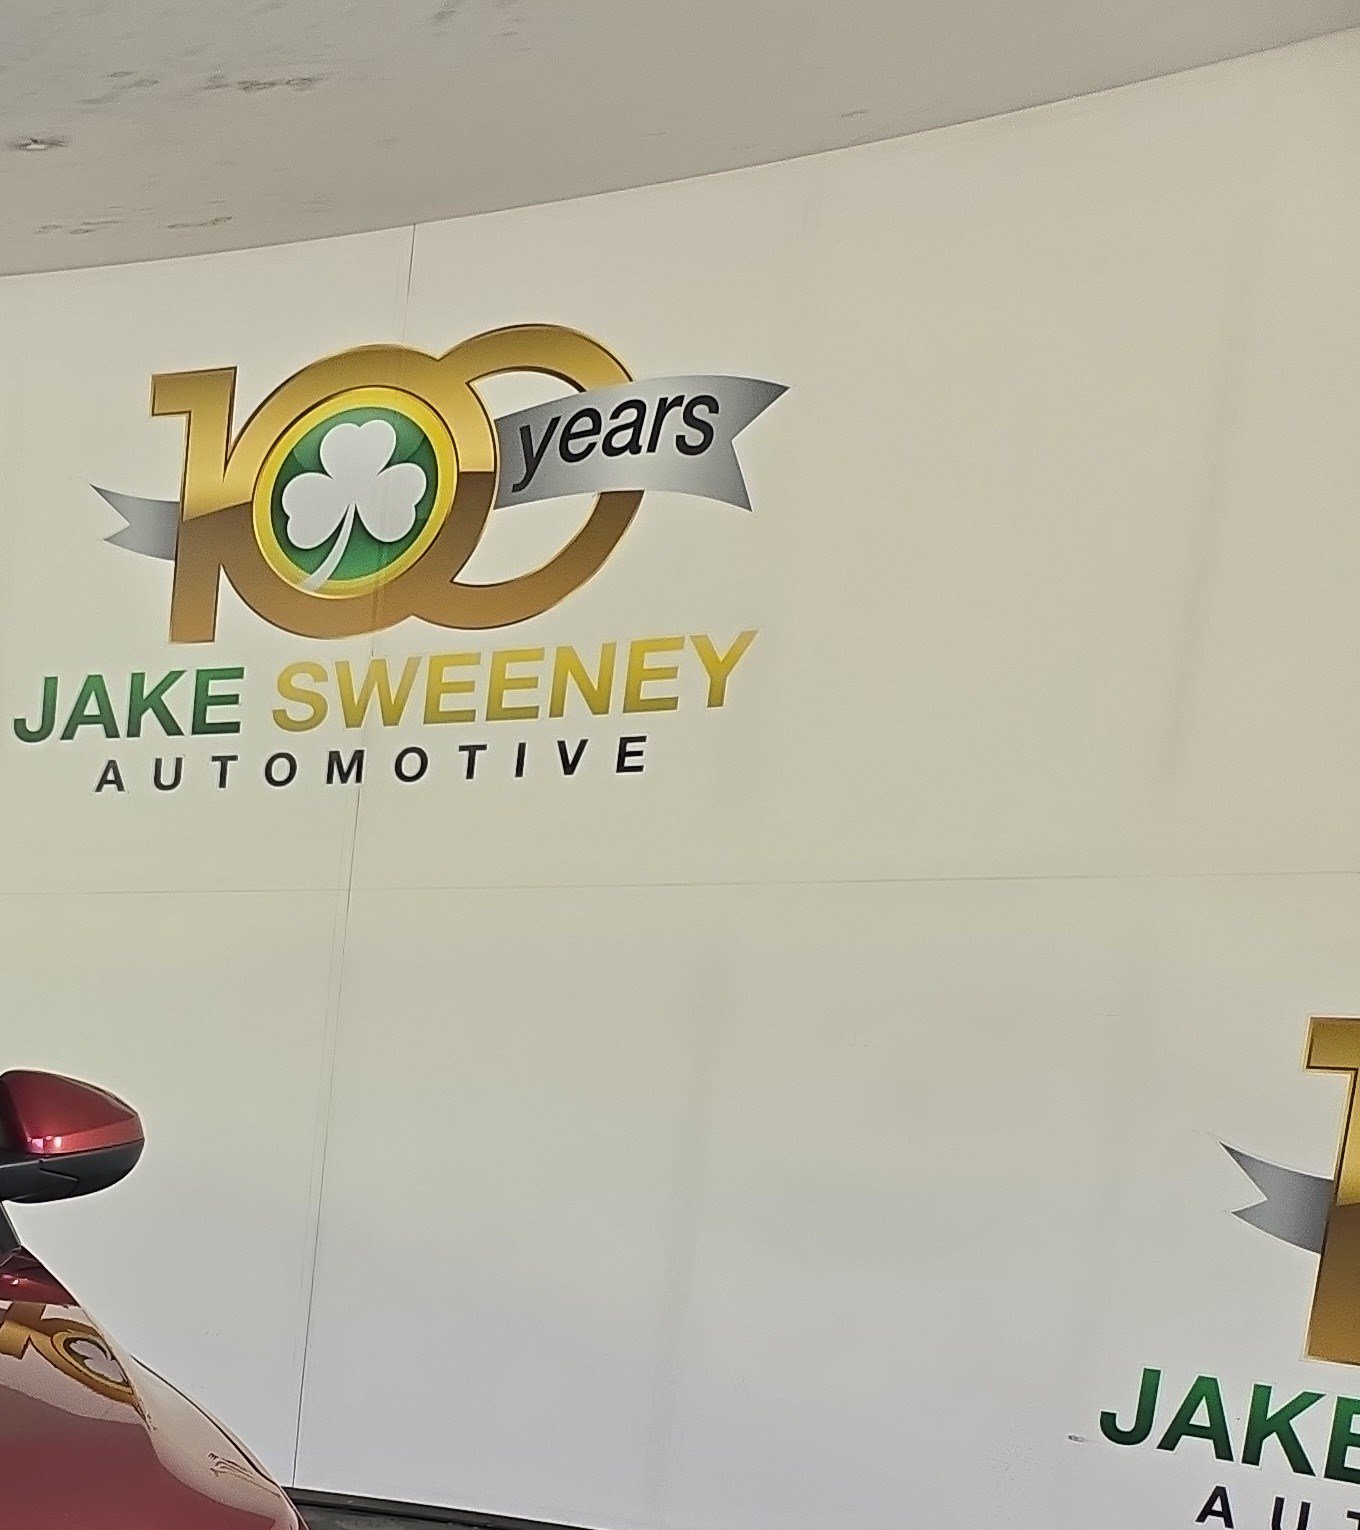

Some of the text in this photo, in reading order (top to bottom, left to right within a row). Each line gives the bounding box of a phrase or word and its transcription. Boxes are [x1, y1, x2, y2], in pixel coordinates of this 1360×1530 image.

[511, 388, 720, 491] years
[13, 630, 759, 744] JAKE SWEENEY
[94, 735, 648, 793] AUTOMOTIVE
